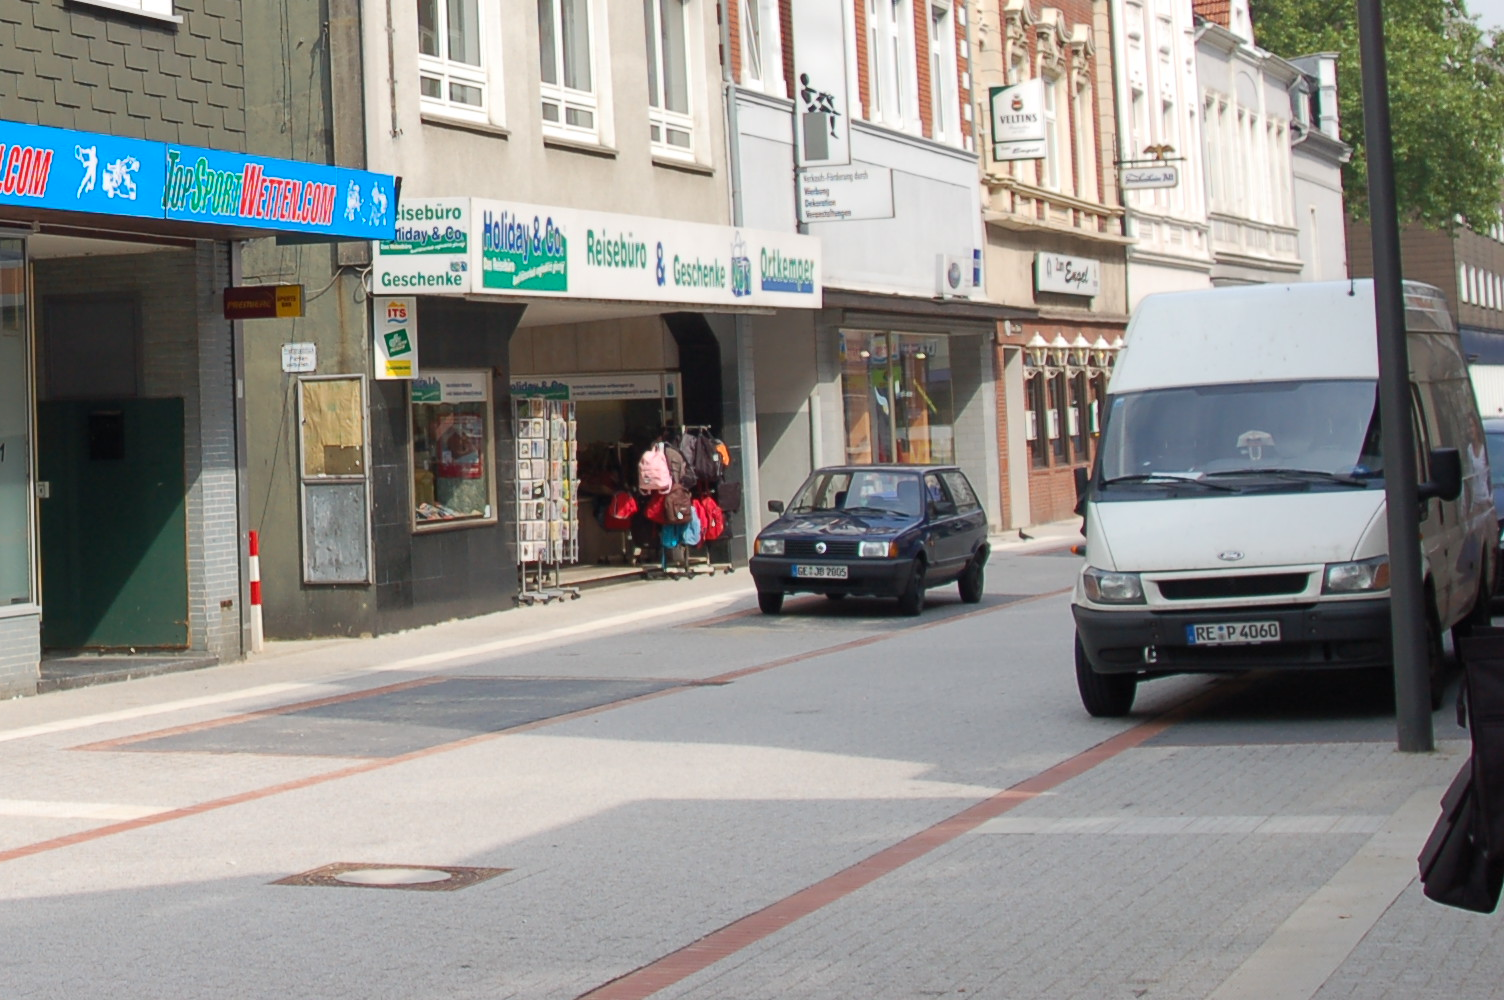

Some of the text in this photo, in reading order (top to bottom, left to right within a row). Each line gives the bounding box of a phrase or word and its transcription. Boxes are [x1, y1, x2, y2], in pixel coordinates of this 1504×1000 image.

[1000, 114, 1037, 125] VELTINS
[397, 204, 462, 221] eisebüro
[432, 227, 441, 241] &
[483, 210, 529, 264] Holiday
[533, 215, 542, 255] &
[587, 230, 646, 269] Reisebüro
[656, 241, 666, 287] &
[674, 254, 726, 288] Geschenke
[760, 247, 814, 290] Ortkemper
[381, 272, 462, 287] Geschenke
[1065, 261, 1089, 290] Engel
[387, 308, 406, 318] ITS
[0, 443, 5, 462] 1
[1196, 623, 1278, 641] RE P 4060
